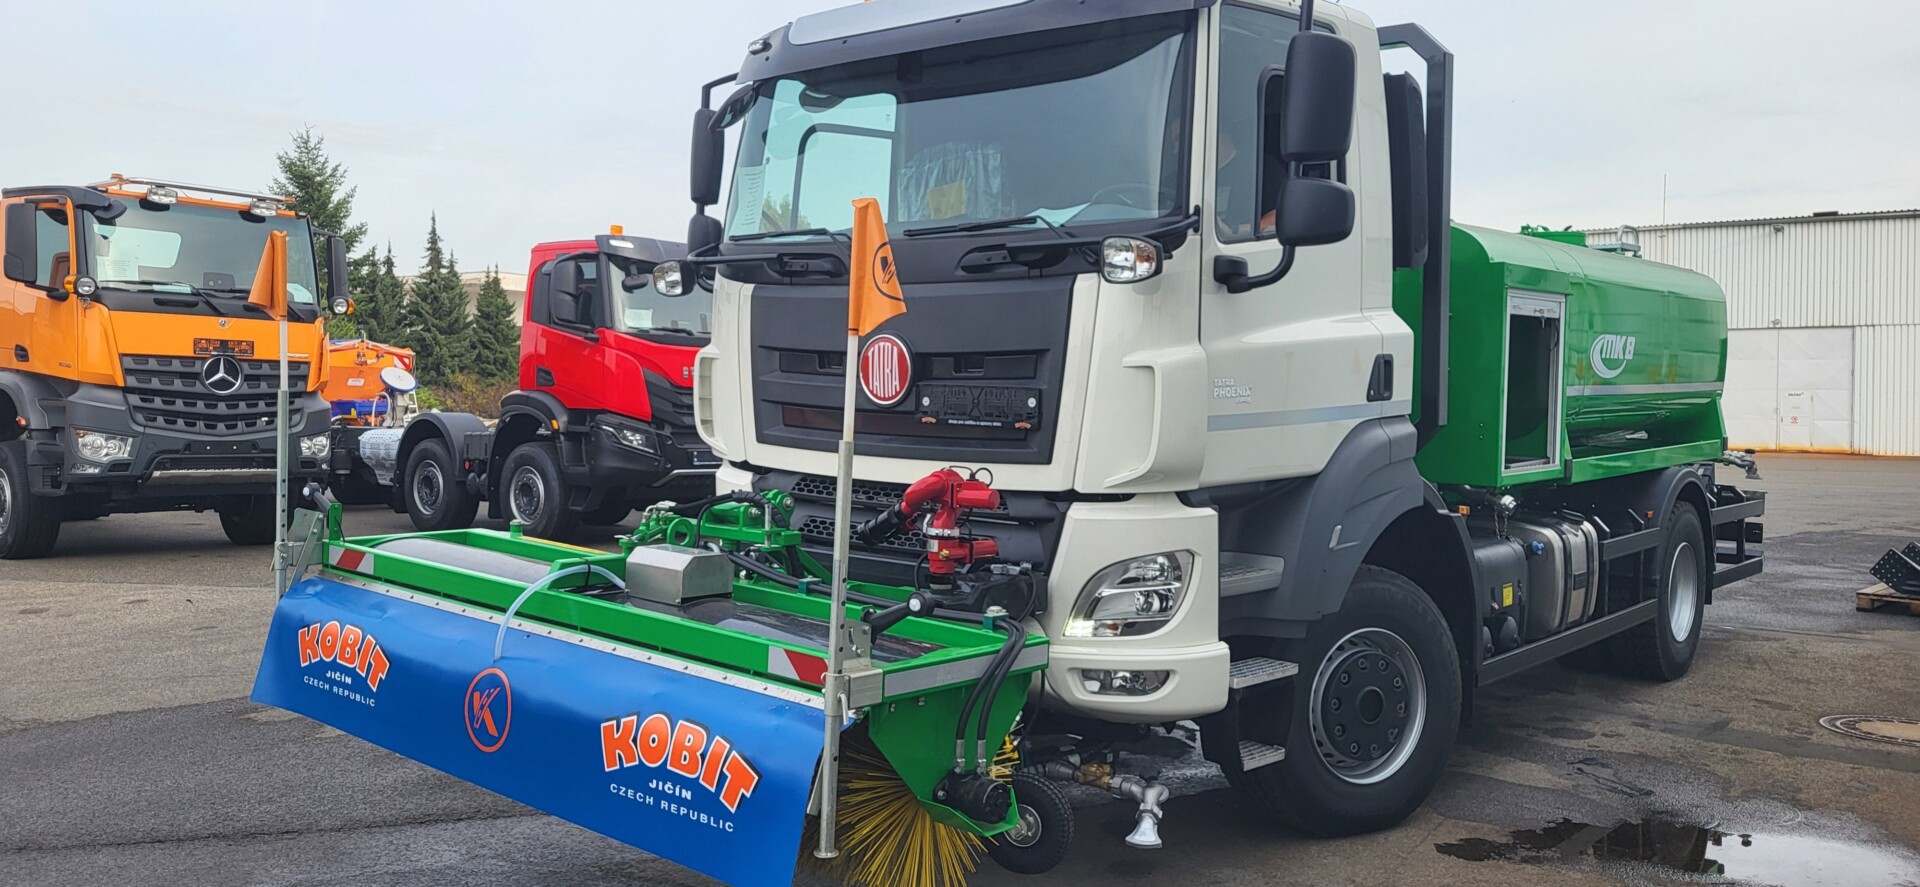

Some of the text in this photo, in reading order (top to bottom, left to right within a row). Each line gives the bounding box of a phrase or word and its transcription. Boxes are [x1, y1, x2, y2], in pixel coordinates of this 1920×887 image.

[867, 341, 900, 398] TATRA
[1214, 378, 1235, 387] TATRA
[1213, 386, 1252, 398] PHOENIX
[298, 620, 391, 693] KOBIT
[303, 675, 376, 707] CZECH REPUBLIC
[325, 669, 352, 685] JIČÍN
[600, 712, 761, 814] KOBIT
[648, 779, 692, 800] JIČÍN
[609, 783, 734, 832] CZECH REPUBLIC
